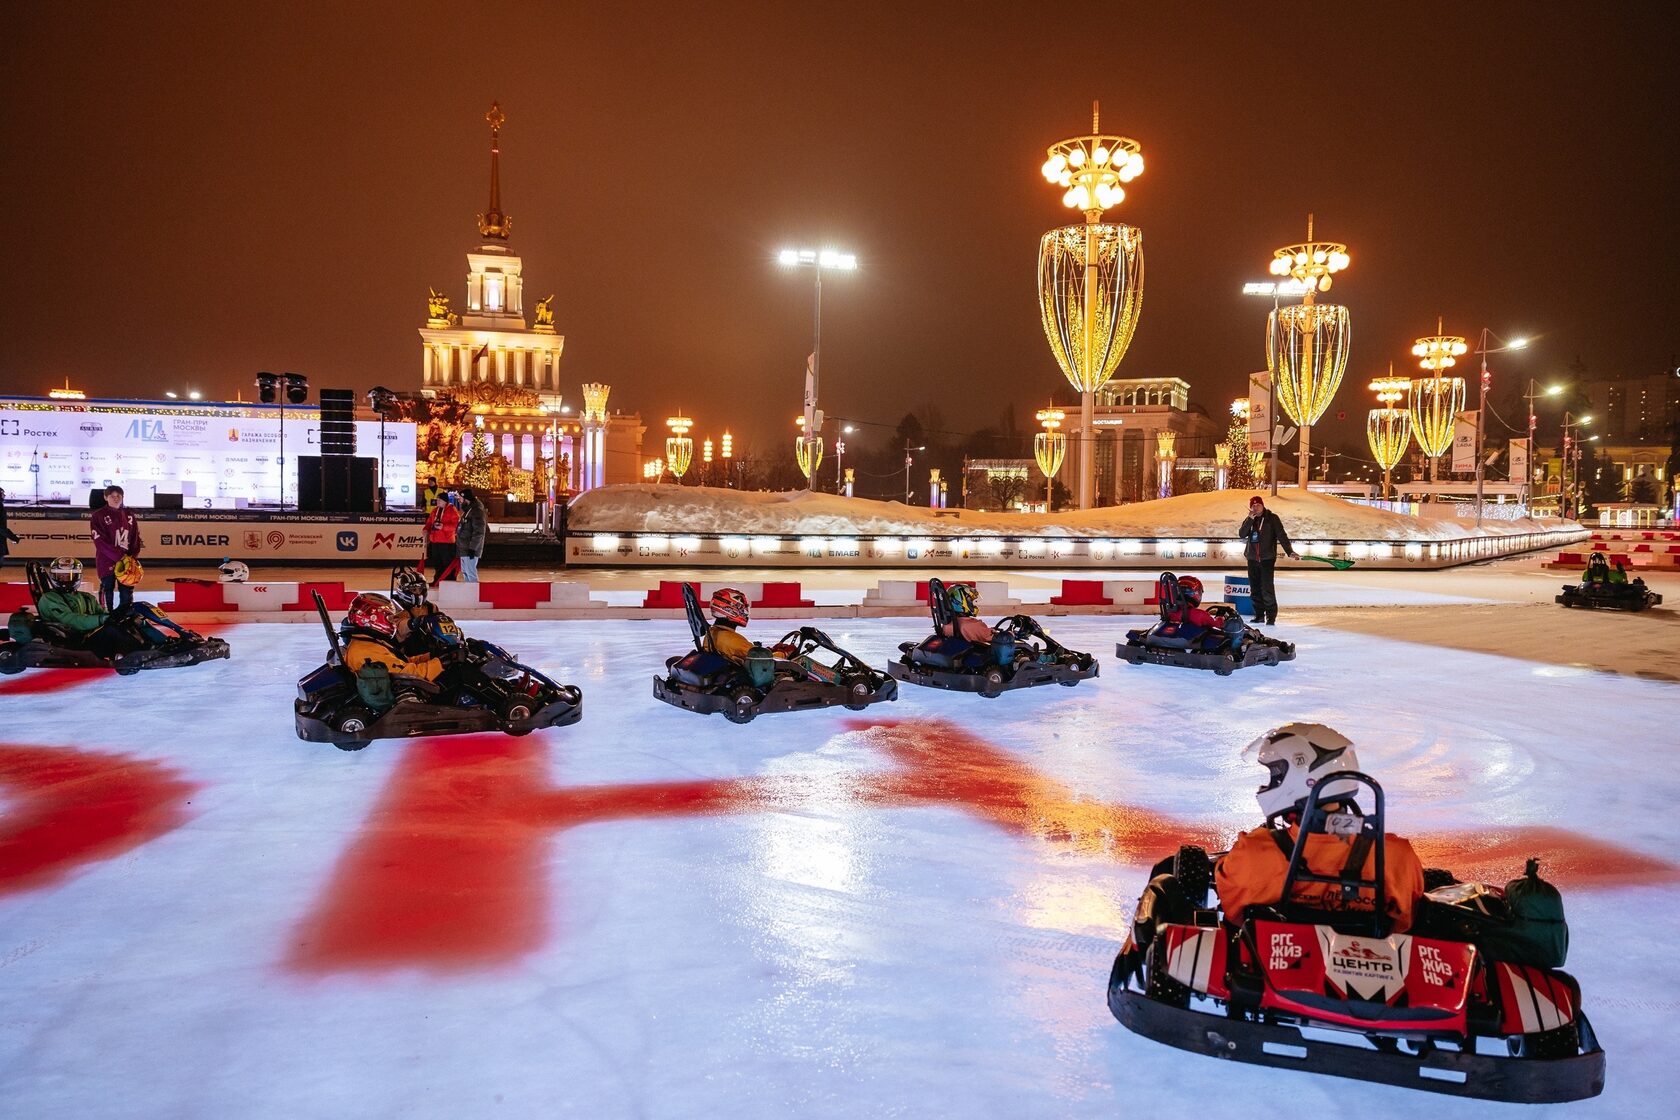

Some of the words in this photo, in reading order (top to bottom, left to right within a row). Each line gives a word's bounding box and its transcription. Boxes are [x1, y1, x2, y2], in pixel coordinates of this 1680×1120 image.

[23, 428, 58, 438] Ростех
[204, 499, 212, 509] 3
[92, 529, 101, 540] 2
[175, 534, 230, 546] MAER
[443, 625, 456, 633] 12
[1271, 933, 1294, 946] РГС
[1271, 946, 1302, 958] ЖИЗ
[1418, 945, 1441, 962] РГС
[1269, 958, 1289, 970] НЬ
[1332, 957, 1394, 973] ЦЕНТР
[1422, 958, 1453, 976] ЖИЗ
[1333, 968, 1364, 978] РАЗВИТИЯ
[1364, 971, 1395, 981] КАРТИНГА
[1423, 971, 1444, 986] НЬ
